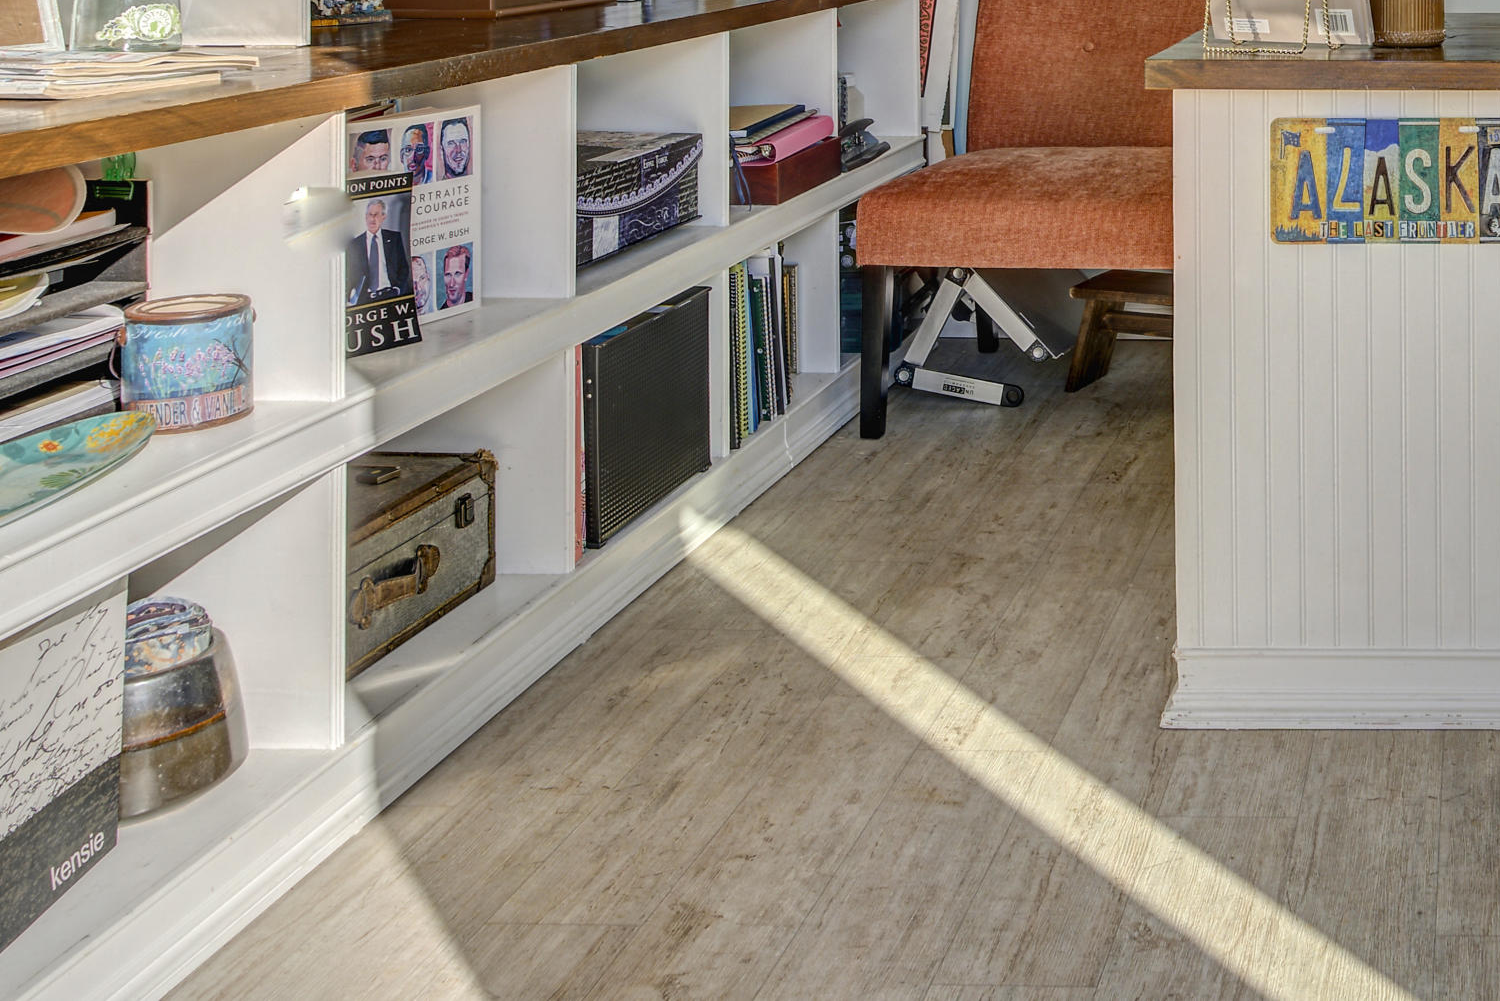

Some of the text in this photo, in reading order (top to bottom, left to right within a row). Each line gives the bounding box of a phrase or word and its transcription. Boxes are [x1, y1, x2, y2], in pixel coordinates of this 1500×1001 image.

[369, 176, 408, 191] POINTS
[411, 184, 471, 206] ORTRAITS
[415, 196, 470, 216] COURAGE
[438, 231, 447, 241] W.
[449, 227, 470, 239] BUSH
[1319, 220, 1475, 239] THE LAST FRONTIER
[346, 302, 415, 327] ORGE W.
[346, 317, 419, 353] USH
[191, 400, 201, 422] &
[50, 830, 105, 891] kensie
